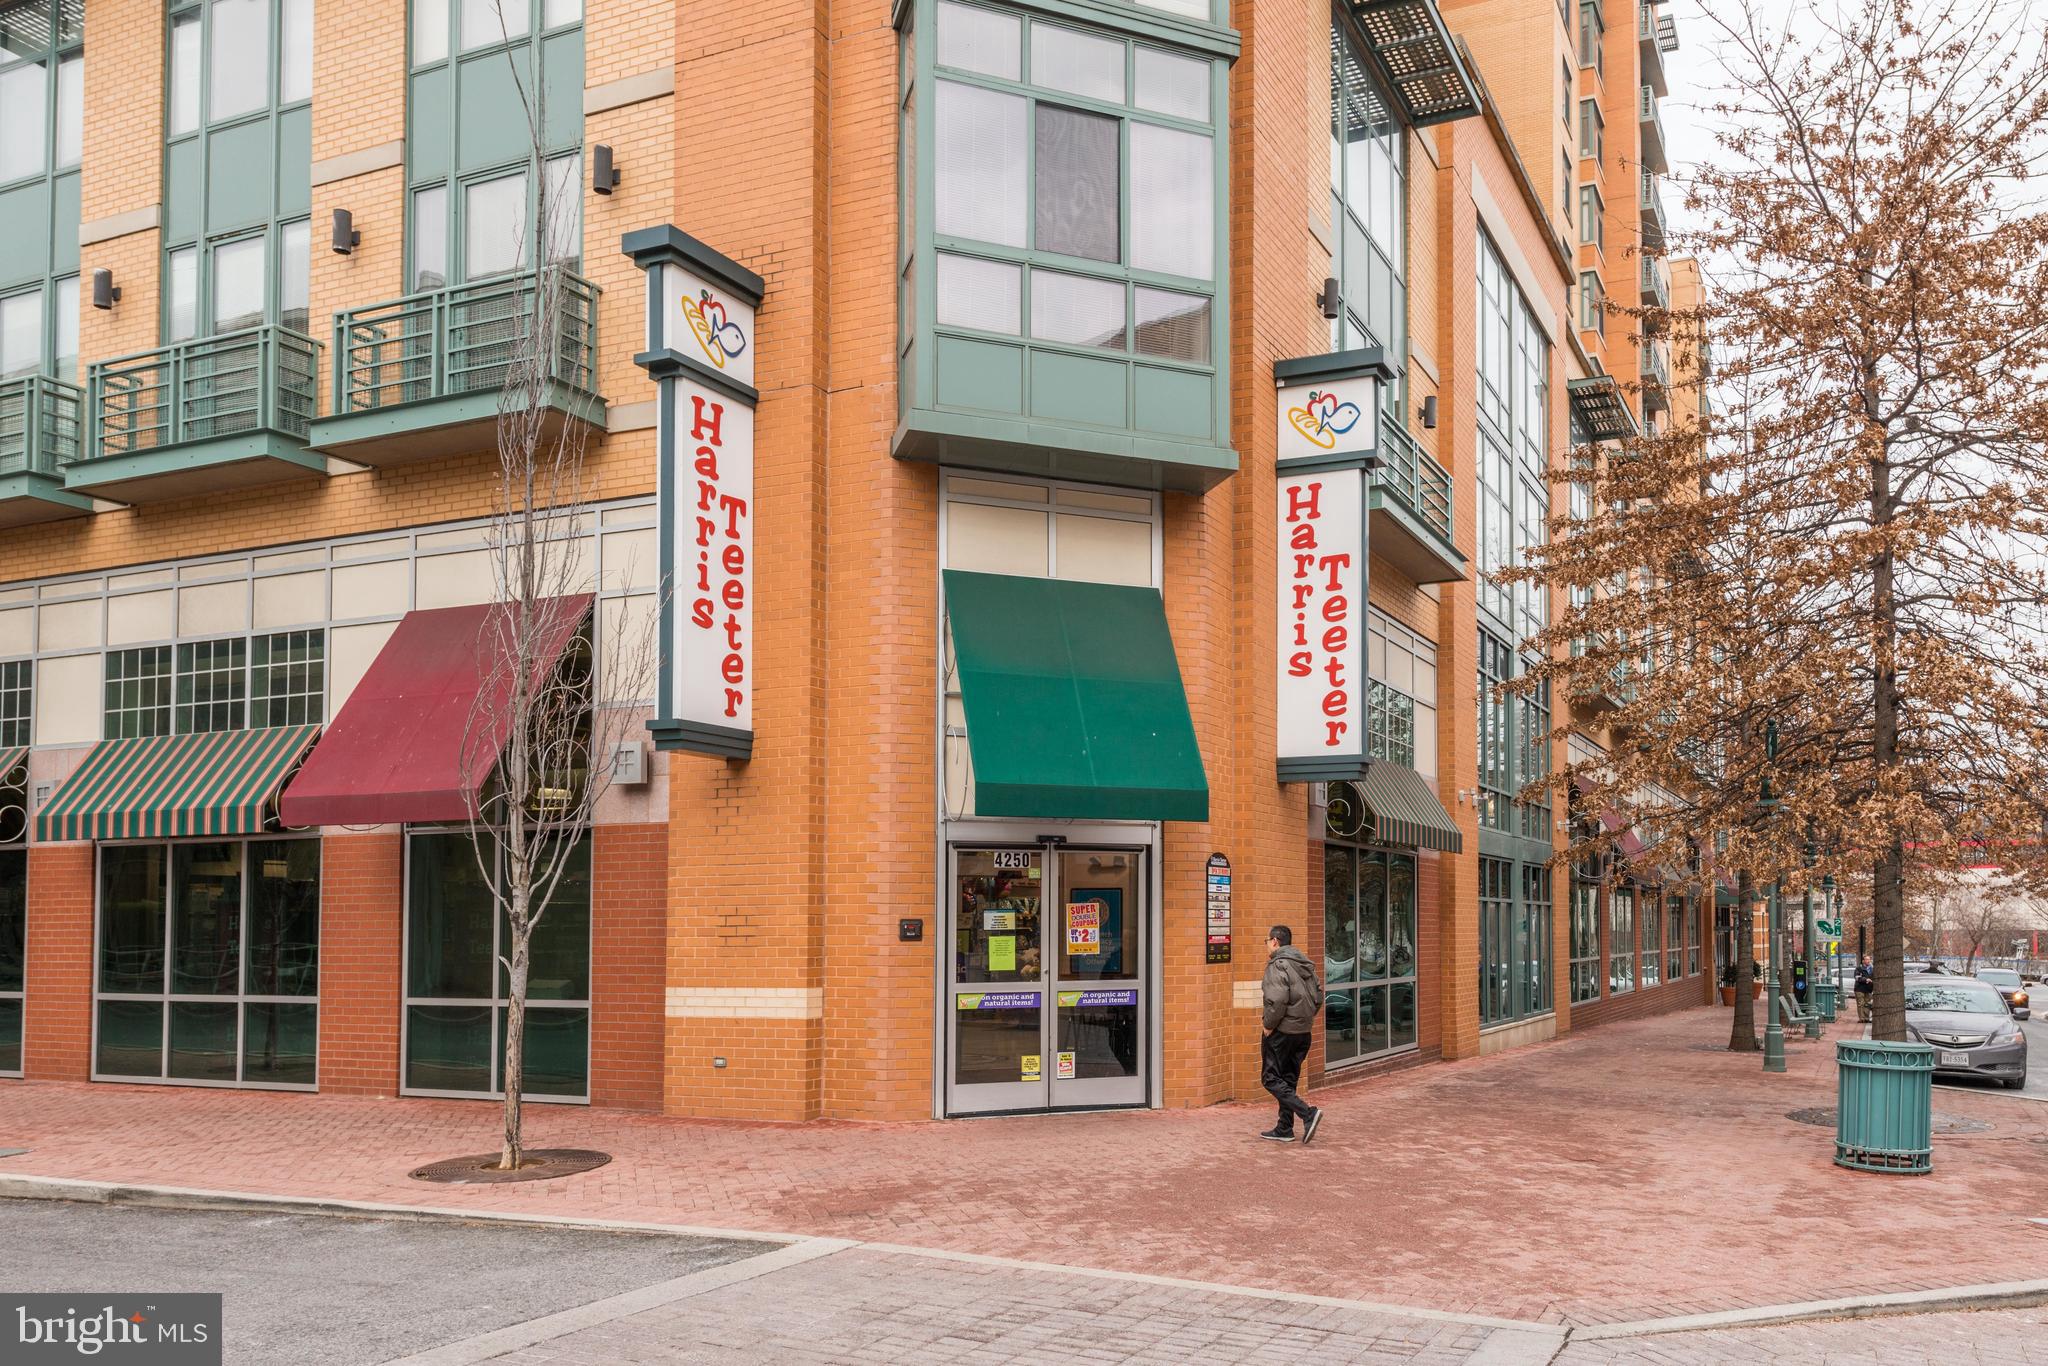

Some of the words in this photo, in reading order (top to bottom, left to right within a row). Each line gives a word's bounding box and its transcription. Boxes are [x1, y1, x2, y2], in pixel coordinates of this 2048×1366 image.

[689, 395, 724, 628] Harris
[1285, 482, 1323, 677] Harris
[719, 495, 747, 717] Teeter
[1319, 552, 1351, 746] Teeter
[994, 853, 1030, 868] 4250
[1070, 904, 1096, 914] SUPER
[1071, 919, 1097, 927] COUPONS
[991, 993, 1020, 1002] organic
[1089, 991, 1116, 999] organic
[984, 999, 1011, 1007] natural
